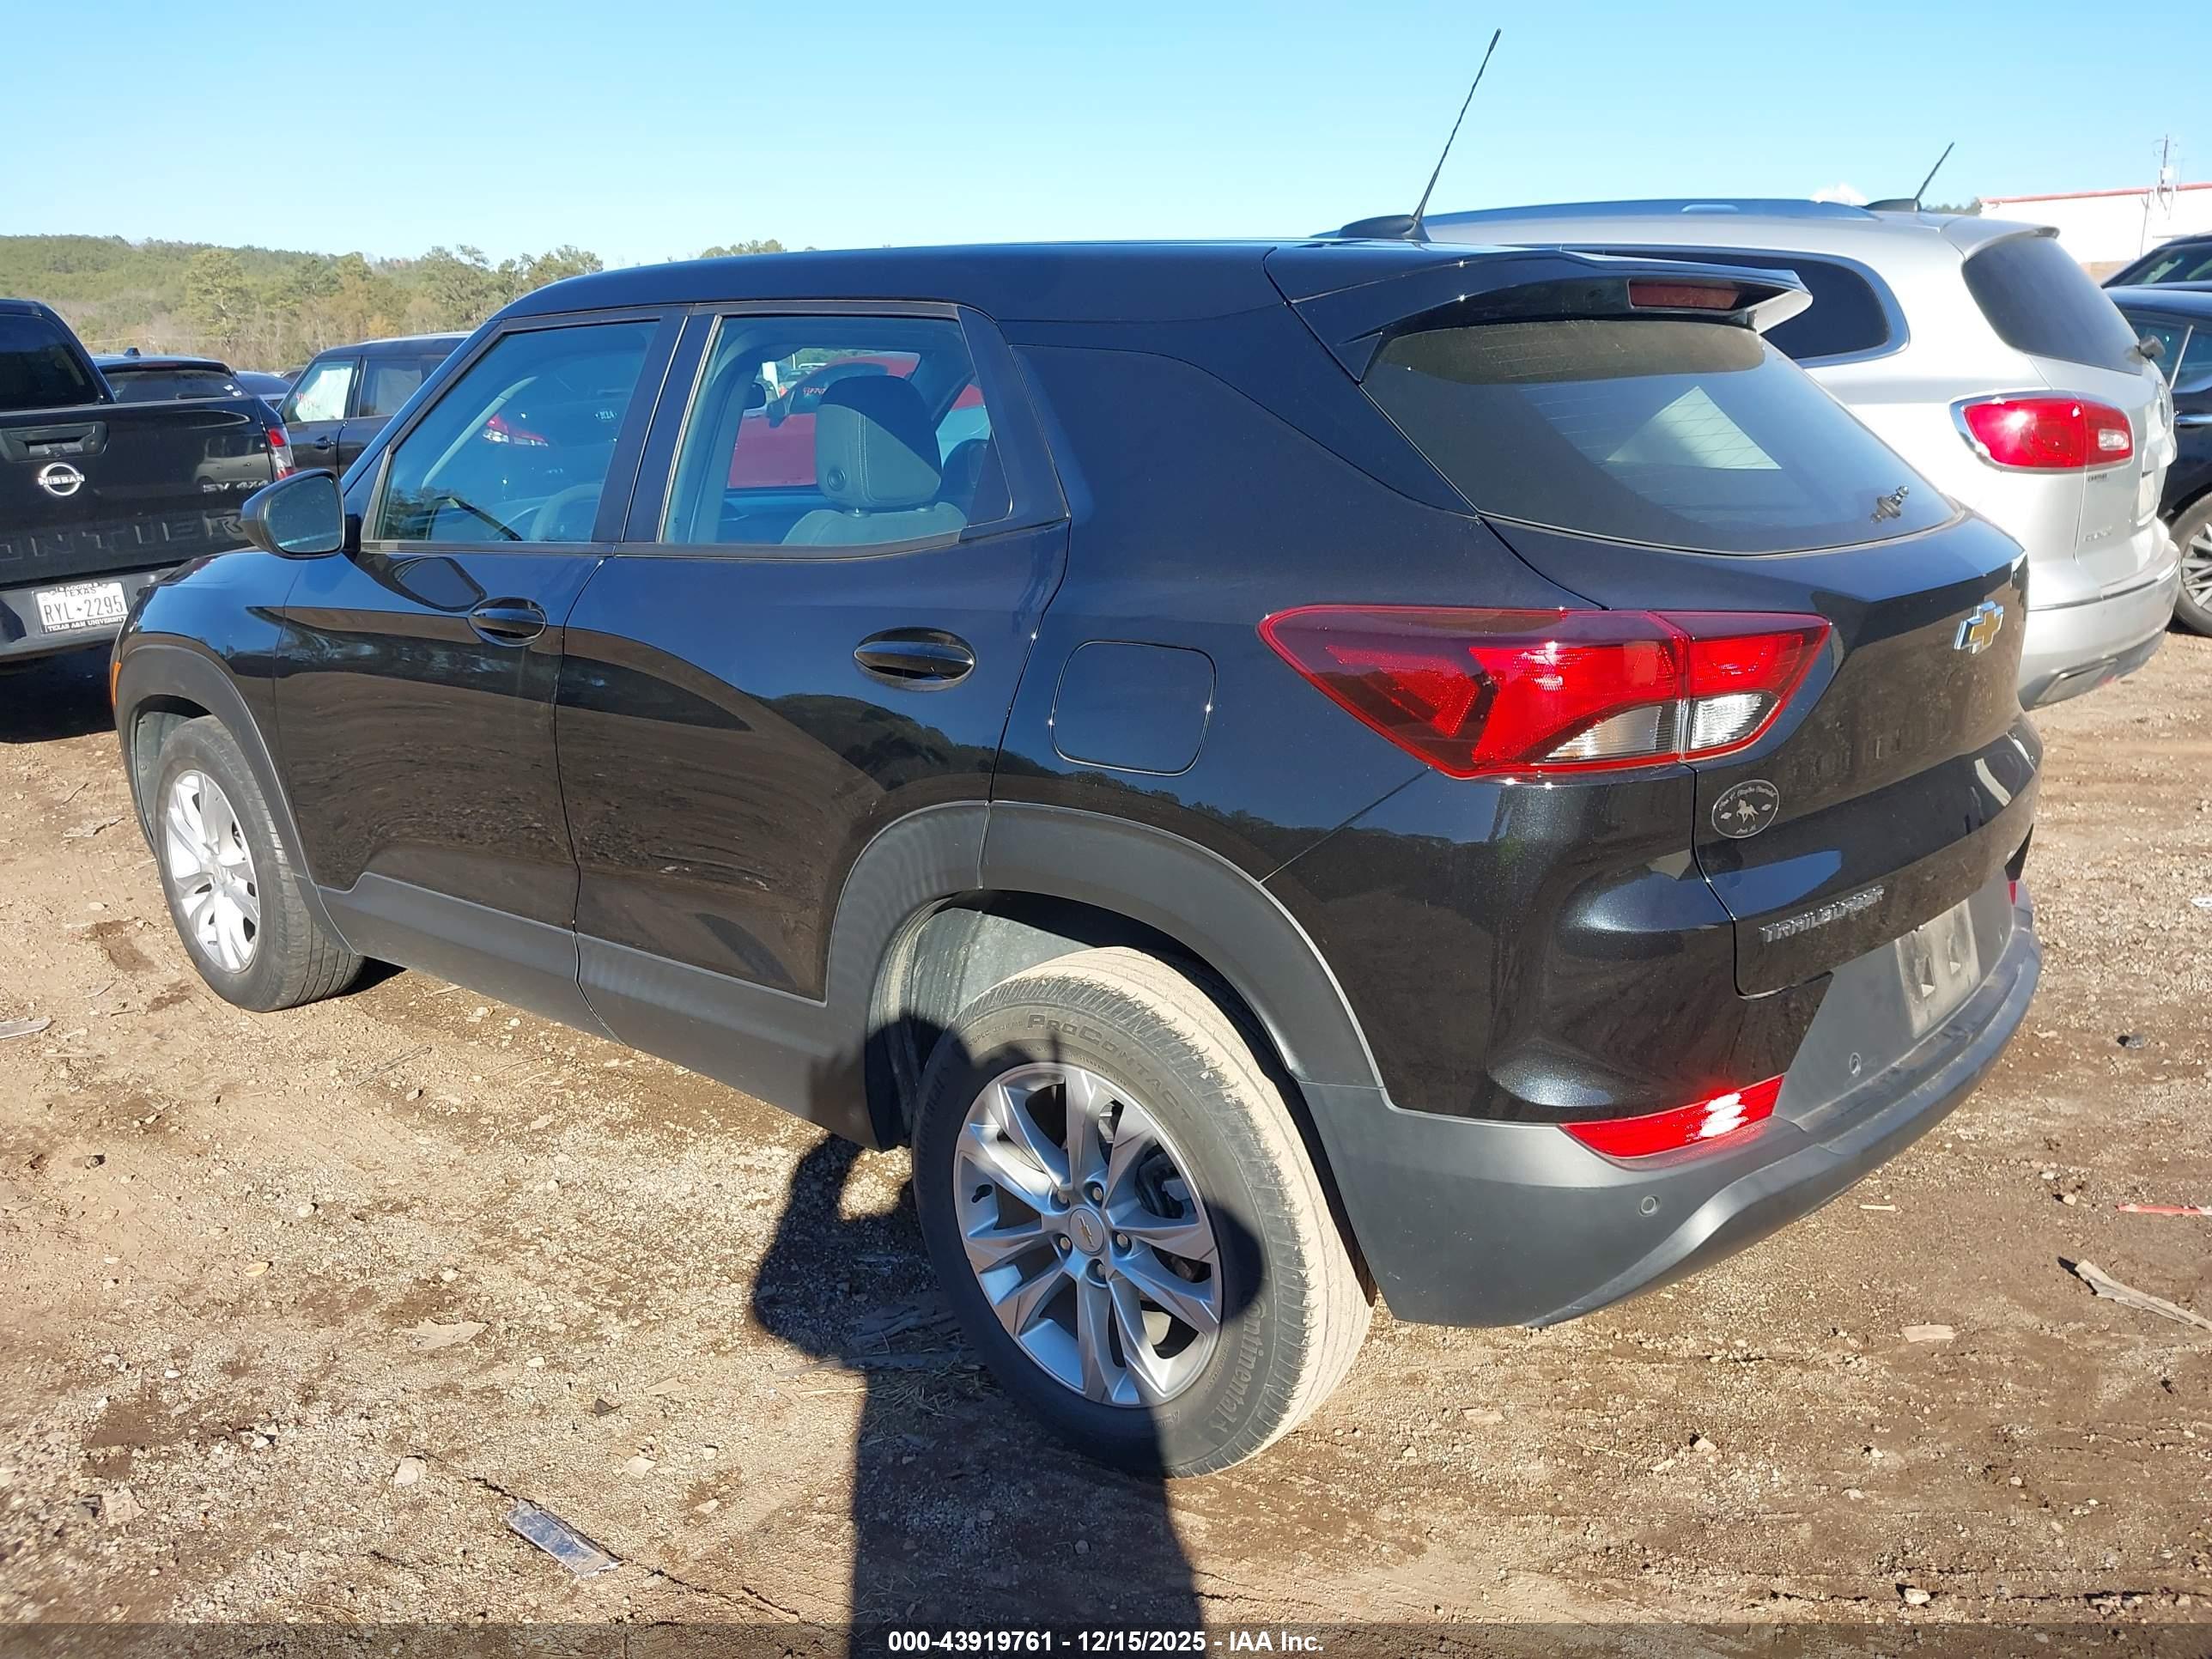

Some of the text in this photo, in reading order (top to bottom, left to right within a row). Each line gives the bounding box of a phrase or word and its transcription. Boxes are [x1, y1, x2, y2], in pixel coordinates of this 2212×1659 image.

[38, 472, 86, 487] NISSAN
[203, 482, 230, 494] SV
[64, 587, 97, 598] TEXAS
[44, 594, 124, 623] RYL 2295
[47, 623, 70, 633] TEXAS
